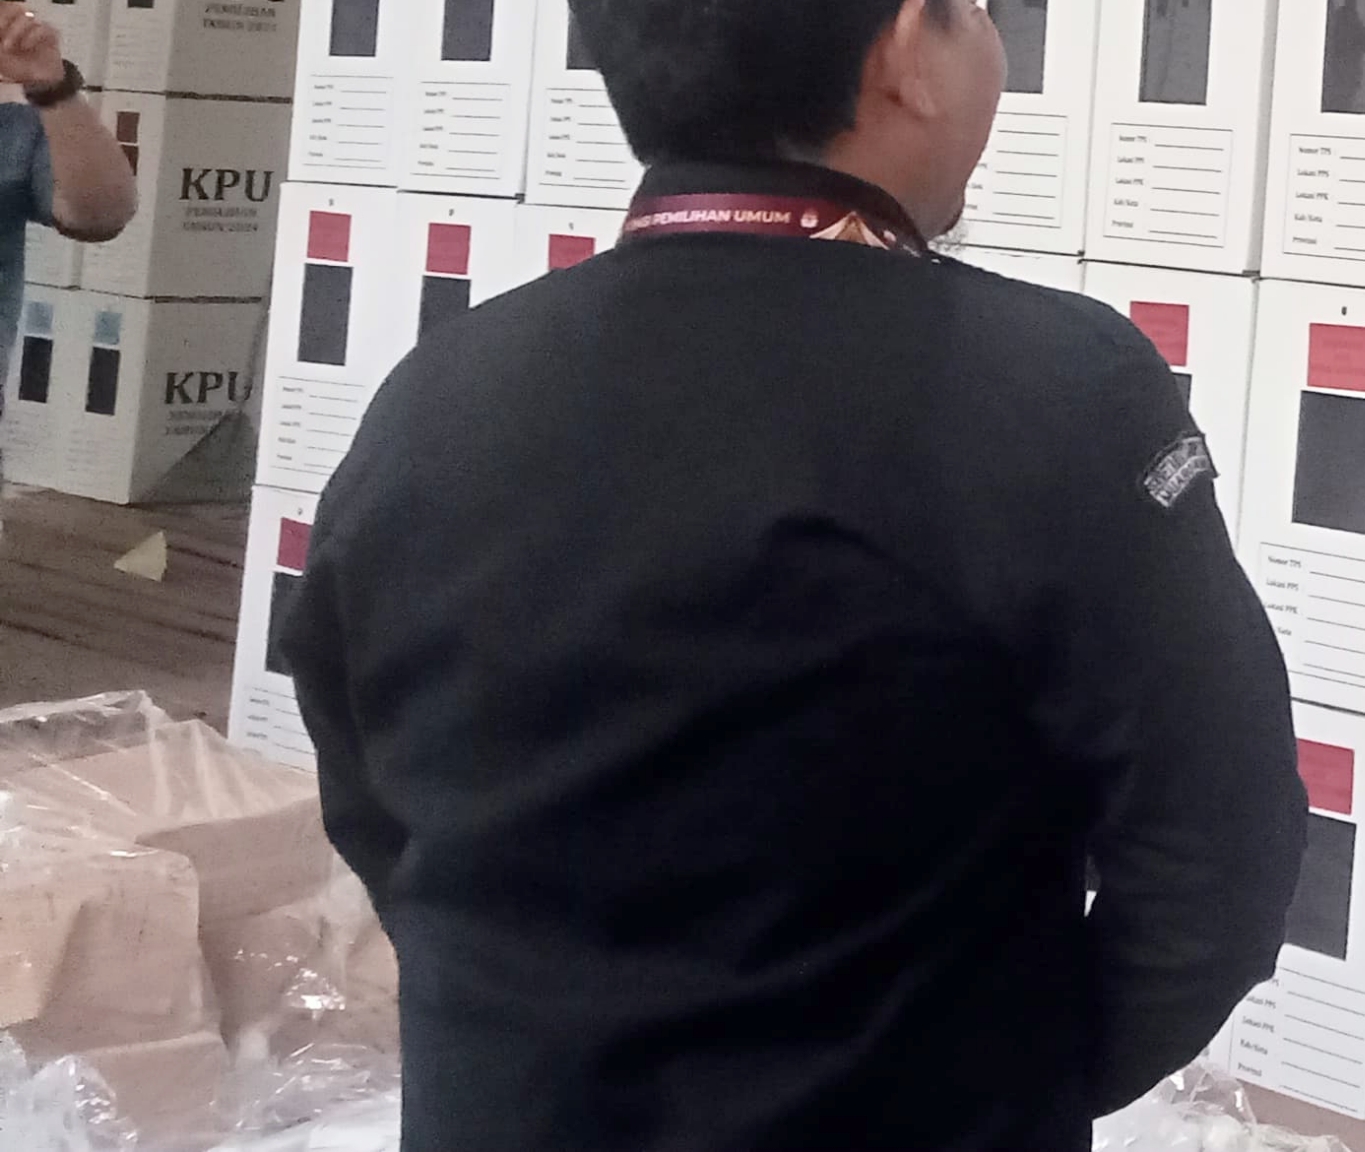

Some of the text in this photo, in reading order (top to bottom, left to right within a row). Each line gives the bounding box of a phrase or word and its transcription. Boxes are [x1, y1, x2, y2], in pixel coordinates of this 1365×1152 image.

[179, 168, 274, 202] KPU
[654, 210, 732, 225] PEMILIHAN
[733, 210, 791, 223] UMUM
[165, 372, 253, 403] KPU
